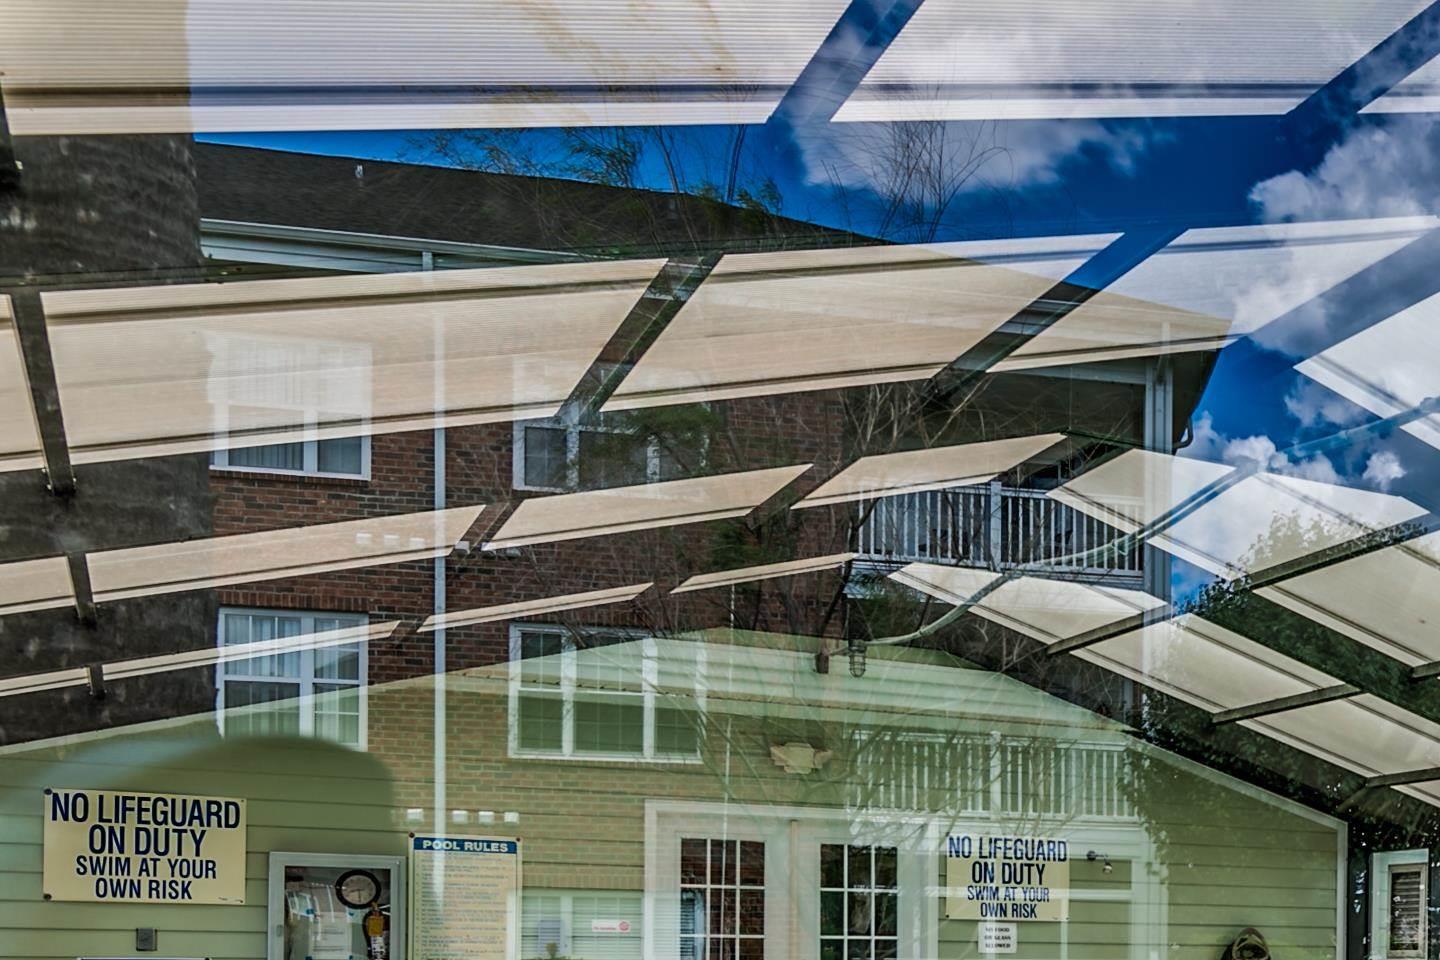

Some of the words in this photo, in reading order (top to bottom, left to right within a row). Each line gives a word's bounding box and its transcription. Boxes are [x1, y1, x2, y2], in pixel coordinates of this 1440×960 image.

[52, 792, 89, 823] NO
[98, 794, 240, 829] LIFEGUARD
[89, 824, 125, 855] ON
[135, 826, 207, 857] DUTY
[422, 840, 460, 850] POOL
[464, 841, 508, 852] RULES
[948, 835, 972, 858] NO
[979, 836, 1067, 862] LIFEGUARD
[76, 855, 130, 876] SWIM
[138, 857, 160, 877] AT
[168, 858, 216, 879] YOUR
[972, 861, 994, 884] ON
[1001, 862, 1046, 885] DUTY
[95, 877, 141, 899] OWN
[149, 879, 192, 900] RISK
[967, 885, 999, 901] SWIM
[1004, 886, 1017, 901] AT
[1022, 887, 1050, 903] YOUR
[980, 902, 1007, 918] OWN
[1011, 903, 1037, 919] RISK
